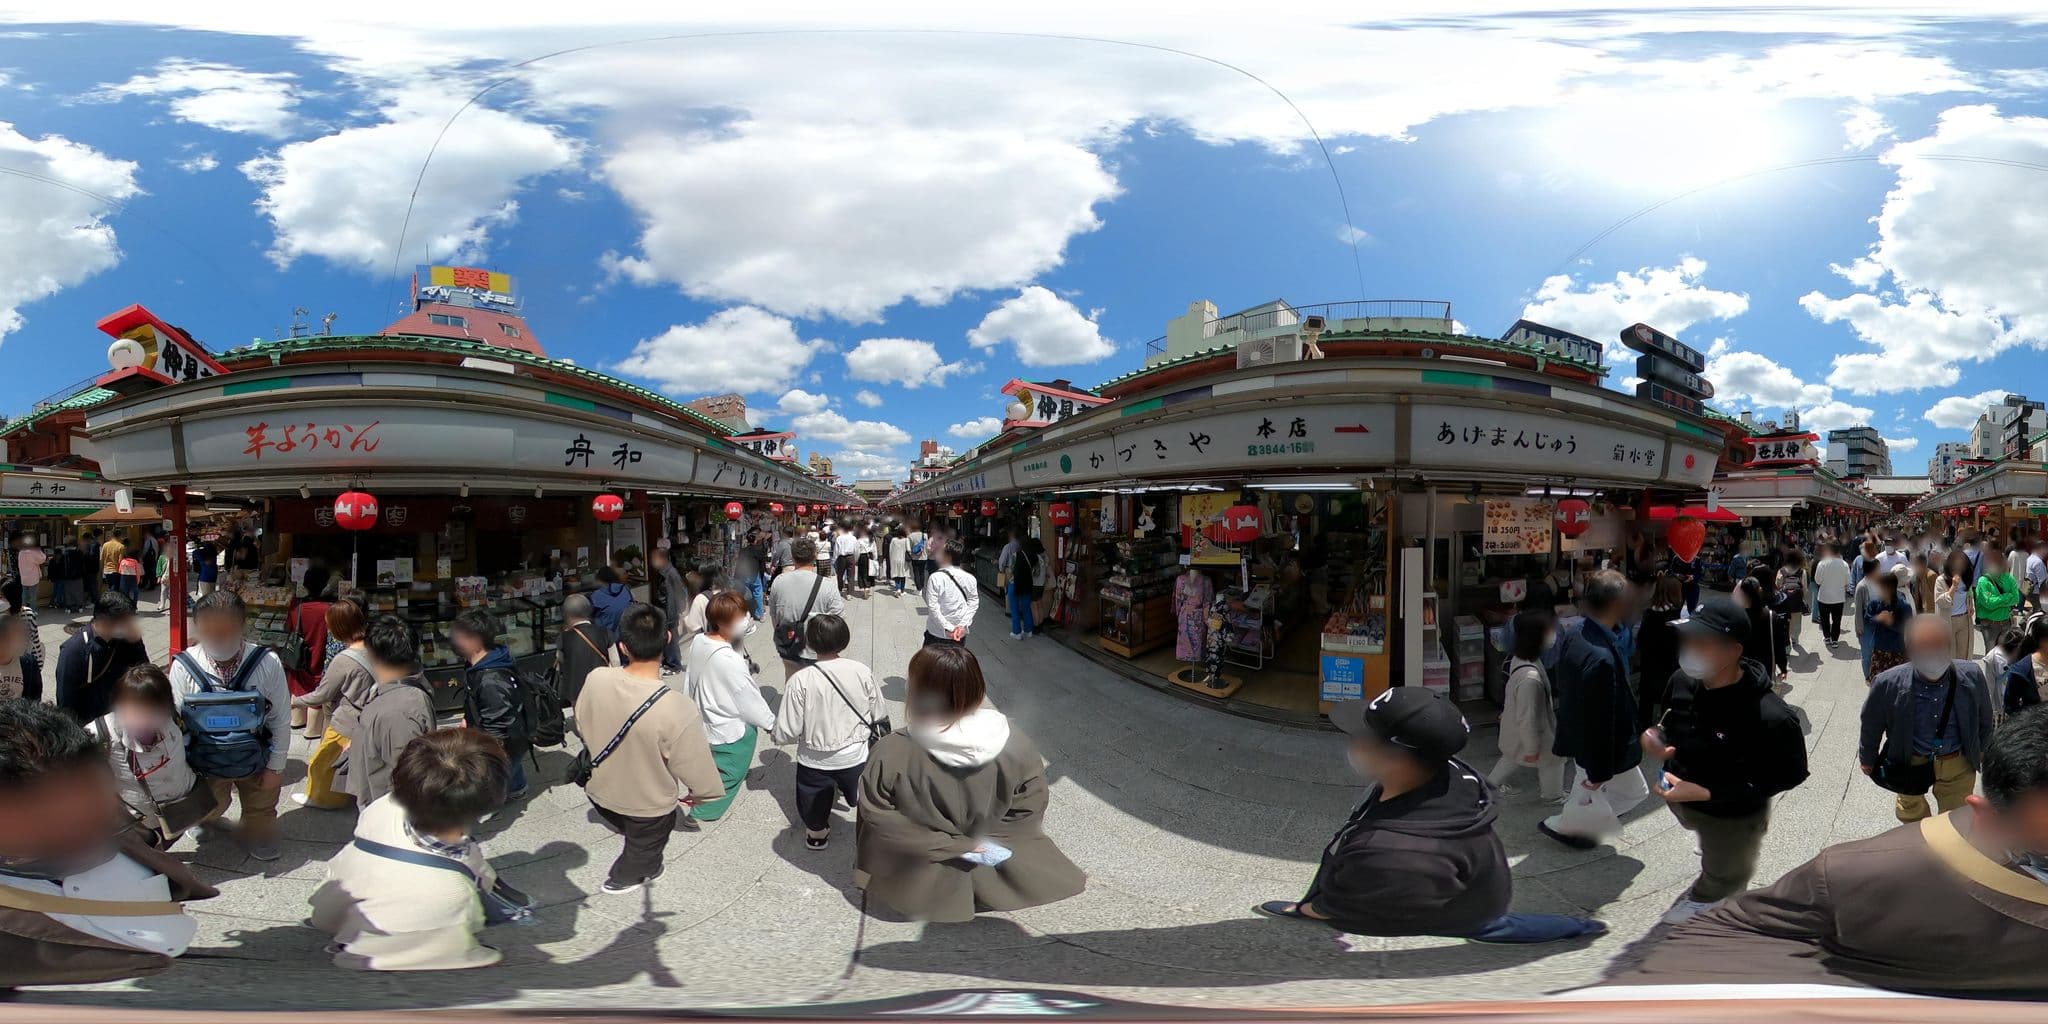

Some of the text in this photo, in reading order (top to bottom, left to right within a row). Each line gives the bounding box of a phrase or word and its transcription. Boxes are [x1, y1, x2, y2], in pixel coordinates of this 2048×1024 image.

[1256, 416, 1307, 439] 本店
[565, 433, 642, 470] 舟和
[1437, 421, 1656, 468] あげまんじゅう 菊水堂
[30, 481, 66, 494] 舟和
